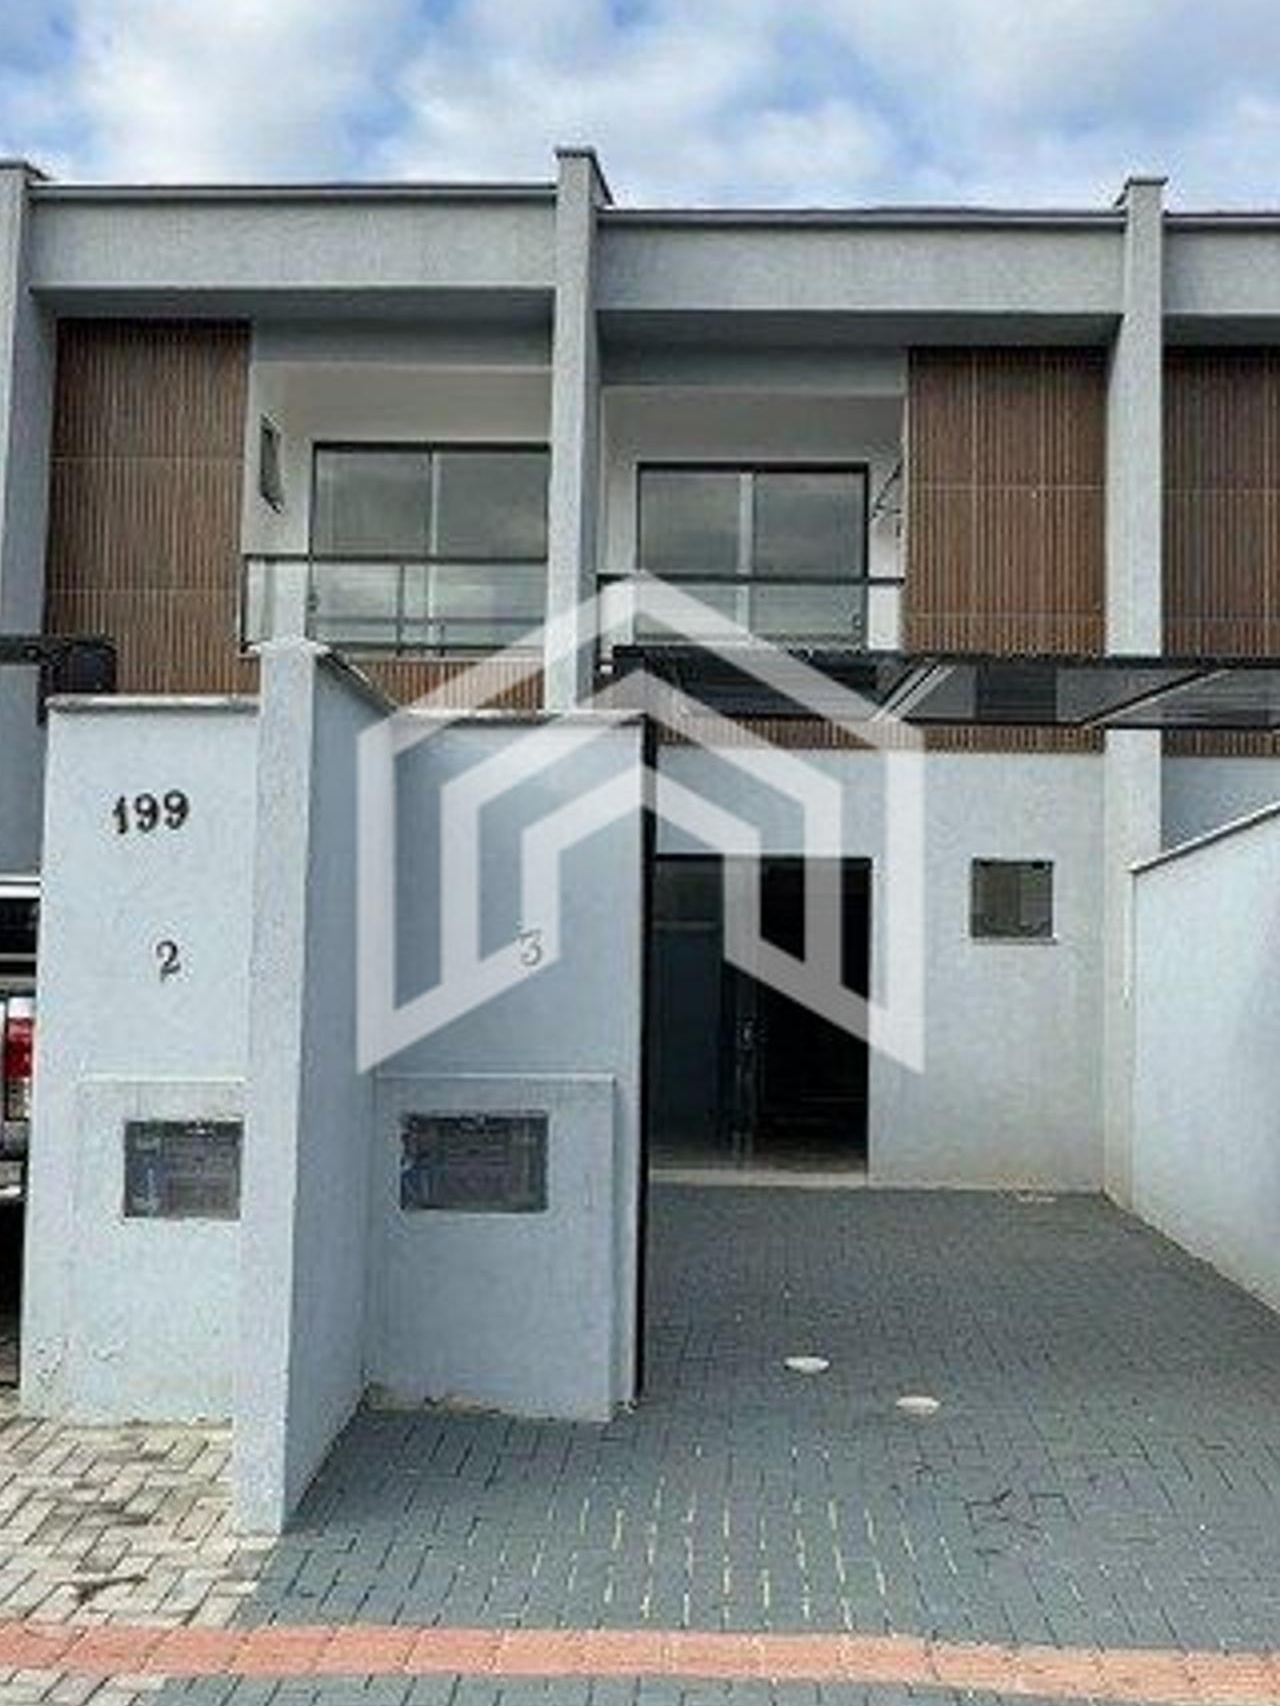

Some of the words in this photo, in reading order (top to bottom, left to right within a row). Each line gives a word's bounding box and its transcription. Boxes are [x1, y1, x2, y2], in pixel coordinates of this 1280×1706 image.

[113, 789, 189, 834] 199
[156, 941, 181, 982] 2
[519, 929, 542, 966] 3
